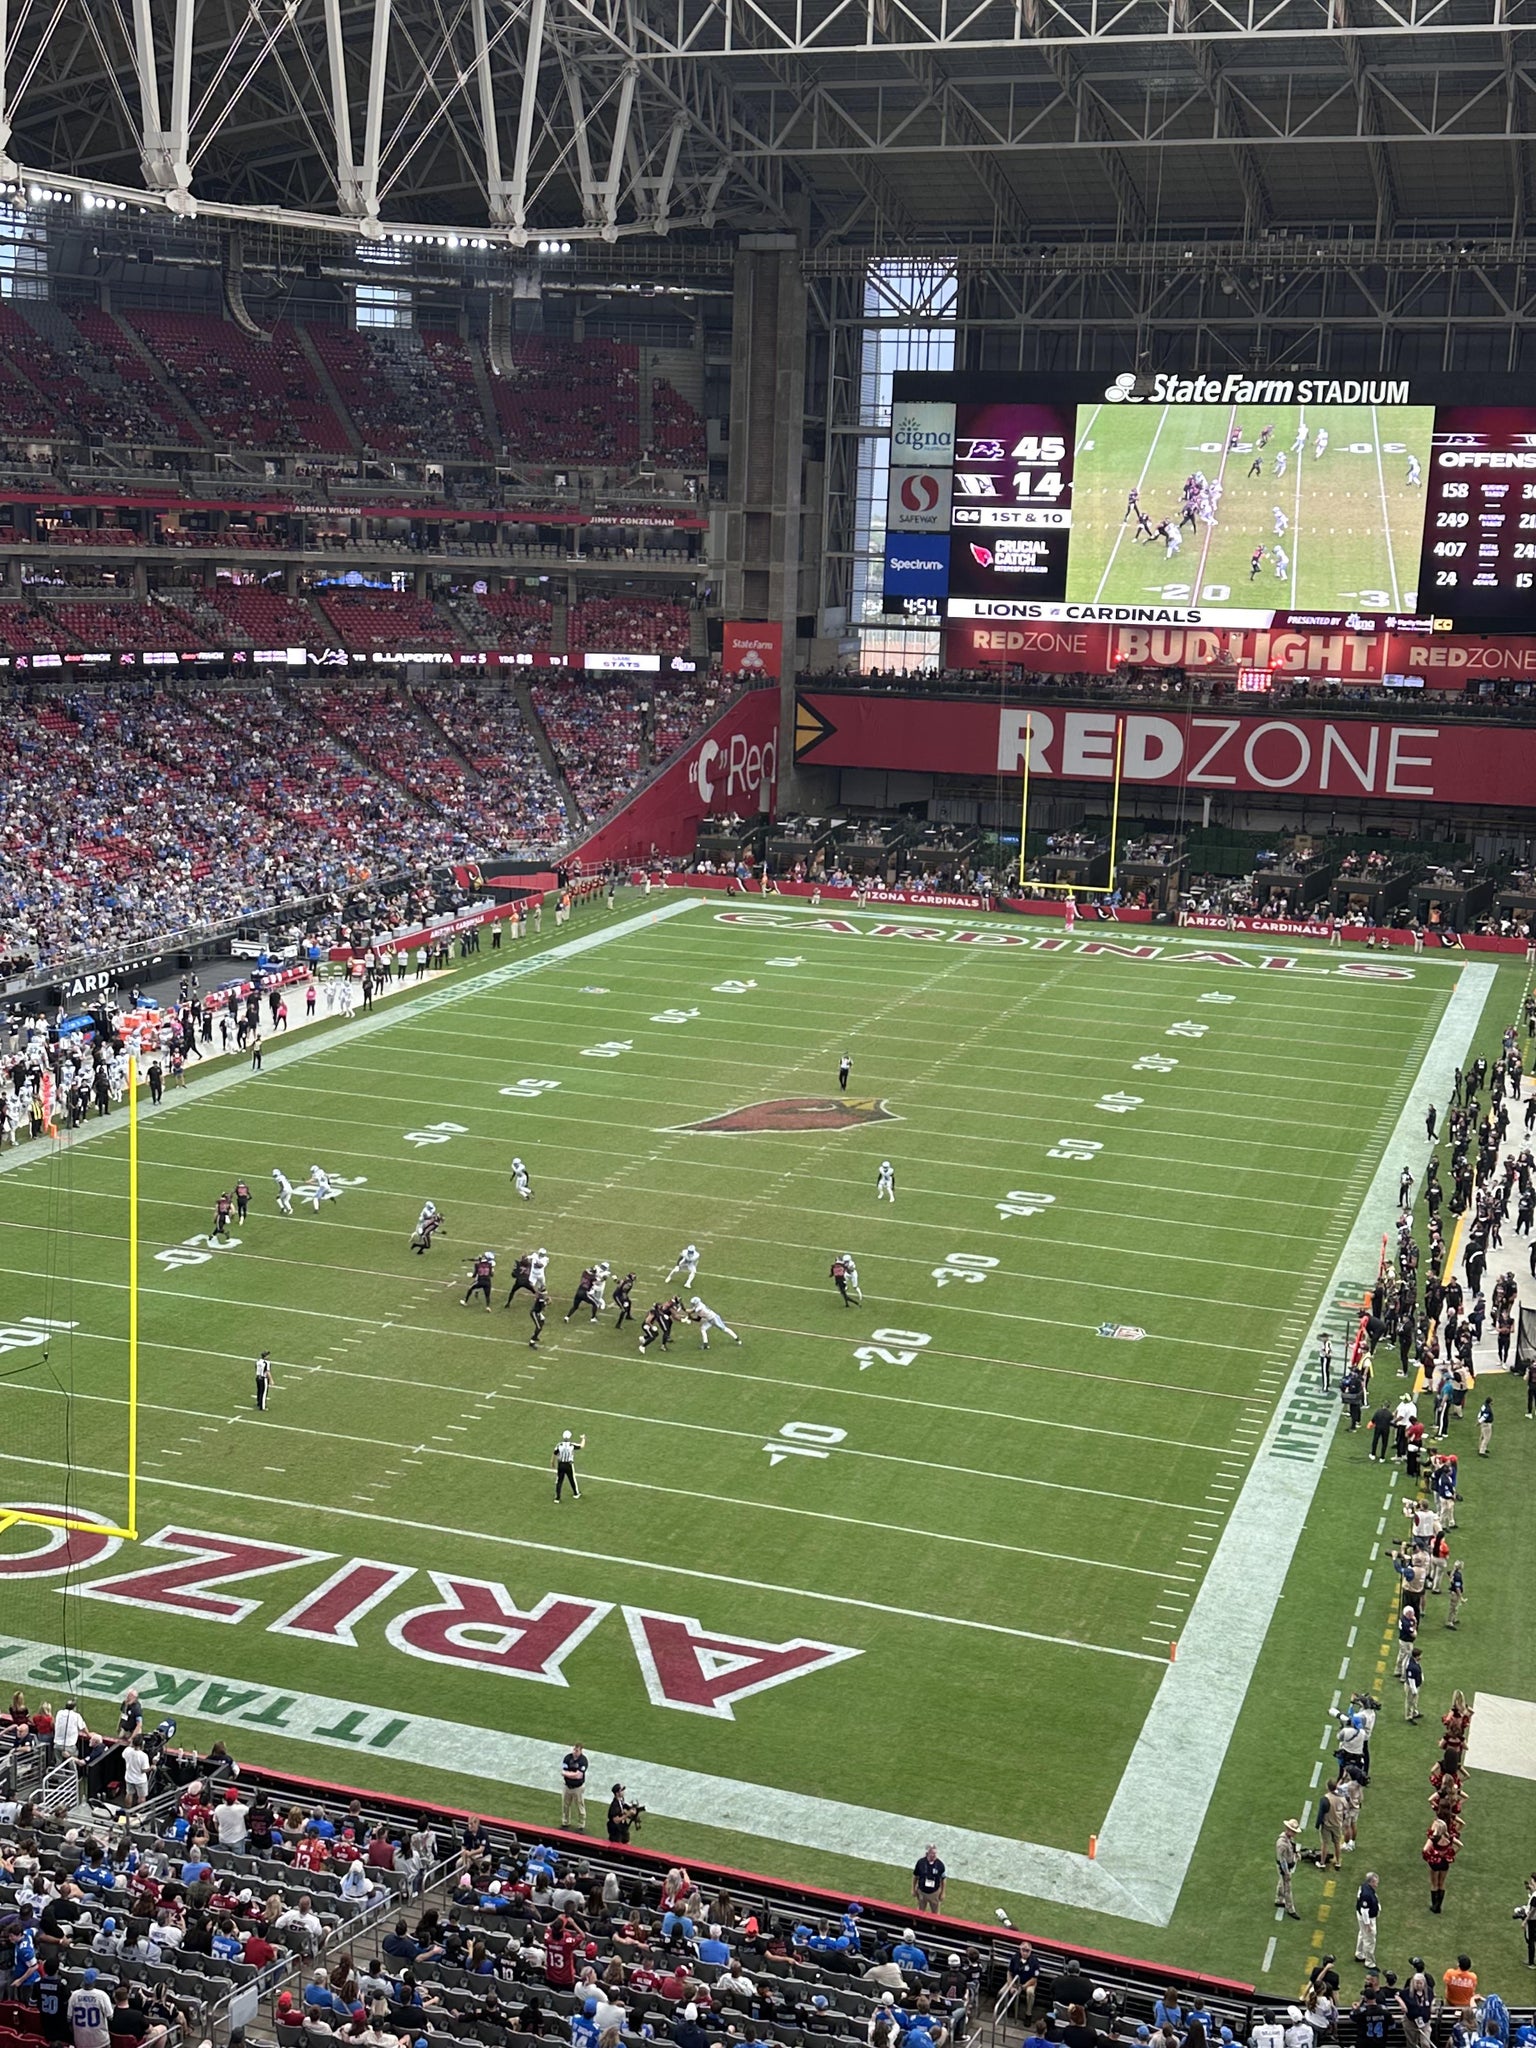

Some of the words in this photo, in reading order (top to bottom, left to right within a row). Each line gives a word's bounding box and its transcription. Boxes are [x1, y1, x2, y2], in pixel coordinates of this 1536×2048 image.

[1297, 380, 1410, 403] STADIUM
[895, 429, 951, 450] cigna
[1011, 436, 1066, 461] 45
[1012, 472, 1065, 496] 14
[1442, 483, 1469, 498] 158
[1522, 484, 1536, 499] 3
[294, 506, 327, 514] ADRIAN
[328, 507, 361, 515] WILSON
[899, 514, 938, 524] SAFEWAY
[956, 510, 980, 522] Q4
[991, 512, 1021, 523] 1ST
[1025, 512, 1037, 523] &
[1042, 513, 1064, 523] 10
[590, 516, 618, 524] JIMMY
[620, 518, 675, 526] CONZELMAN
[1436, 512, 1469, 527] 249
[995, 540, 1050, 554] CRUCIAL
[1433, 542, 1467, 557] 407
[1513, 543, 1536, 558] 24
[890, 558, 939, 571] Spectrum
[994, 553, 1036, 566] CATCH
[1436, 571, 1458, 586] 24
[1516, 573, 1533, 588] 15
[903, 599, 938, 615] 4:54
[975, 603, 1043, 617] LIONS
[1067, 606, 1202, 623] CARDINALS
[973, 630, 1088, 653] REDZONE
[1118, 628, 1219, 665] BUD
[1230, 632, 1377, 672] LIGHT
[478, 653, 487, 663] 5
[1409, 646, 1536, 670] REDZONE
[998, 709, 1440, 796] REDZONE
[727, 726, 778, 797] Red
[850, 890, 906, 902] AIZONA
[910, 894, 980, 907] CARDINALS
[1186, 916, 1247, 929] ARIZOA
[1252, 921, 1329, 935] CARDINALS
[713, 911, 1416, 981] CARDINALS
[1196, 992, 1237, 1004] 10
[650, 1008, 700, 1024] 30
[1165, 1022, 1210, 1037] 20
[579, 1040, 633, 1057] 40
[1131, 1056, 1179, 1073] 30
[498, 1078, 562, 1098] 50
[1093, 1094, 1145, 1113] 40
[403, 1121, 470, 1144] 40
[1046, 1138, 1105, 1161] 50
[994, 1190, 1057, 1217] 40
[153, 1233, 243, 1265] 20
[930, 1252, 1000, 1284] 30
[853, 1328, 933, 1367] 20
[762, 1421, 848, 1459] 10
[27, 1654, 298, 1728] TAKES
[312, 1710, 412, 1748] IT
[295, 1852, 311, 1869] 13
[549, 1952, 564, 1969] 13
[502, 1967, 514, 1981] 10
[73, 2006, 101, 2028] 20
[1366, 2022, 1384, 2038] 14
